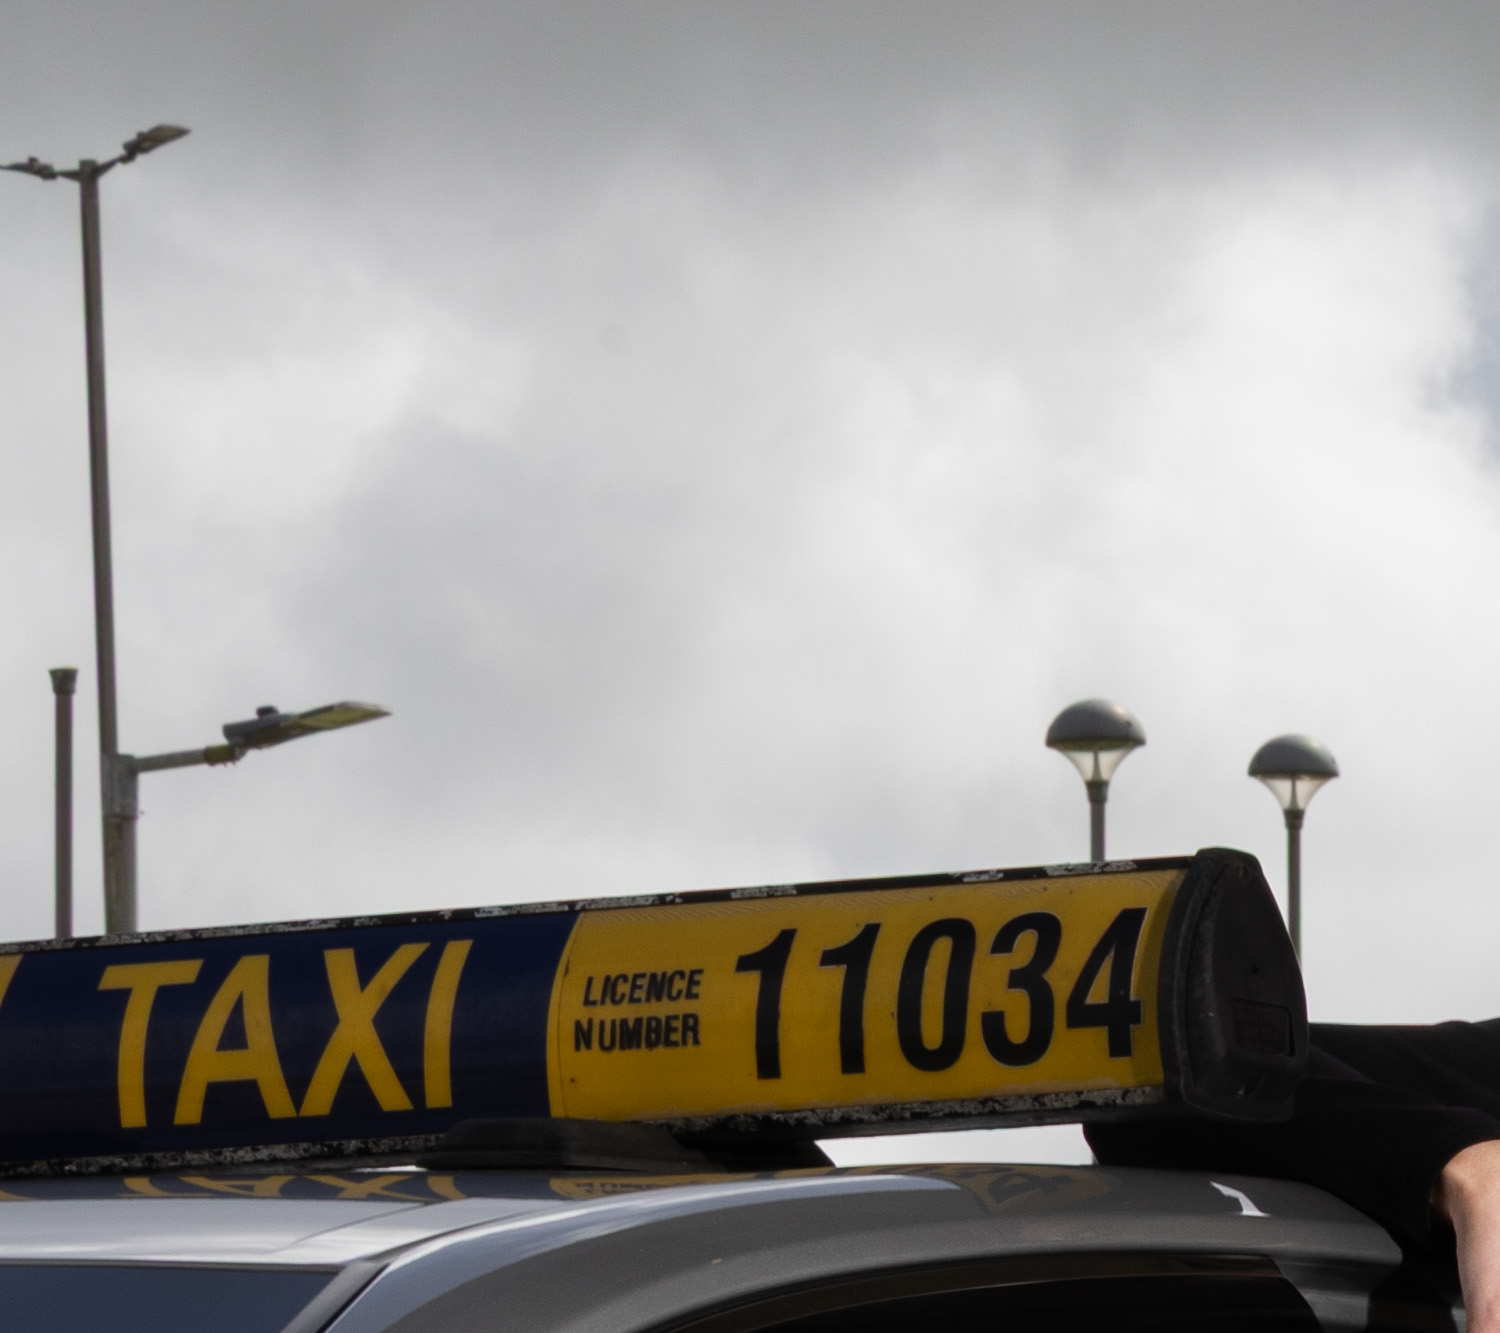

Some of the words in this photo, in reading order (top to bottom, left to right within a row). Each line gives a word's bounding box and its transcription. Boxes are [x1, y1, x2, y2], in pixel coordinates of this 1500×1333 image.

[100, 941, 471, 1128] TAXI
[573, 1012, 702, 1054] NUMBER
[583, 966, 703, 1008] LICENCE
[735, 905, 1149, 1080] 11034
